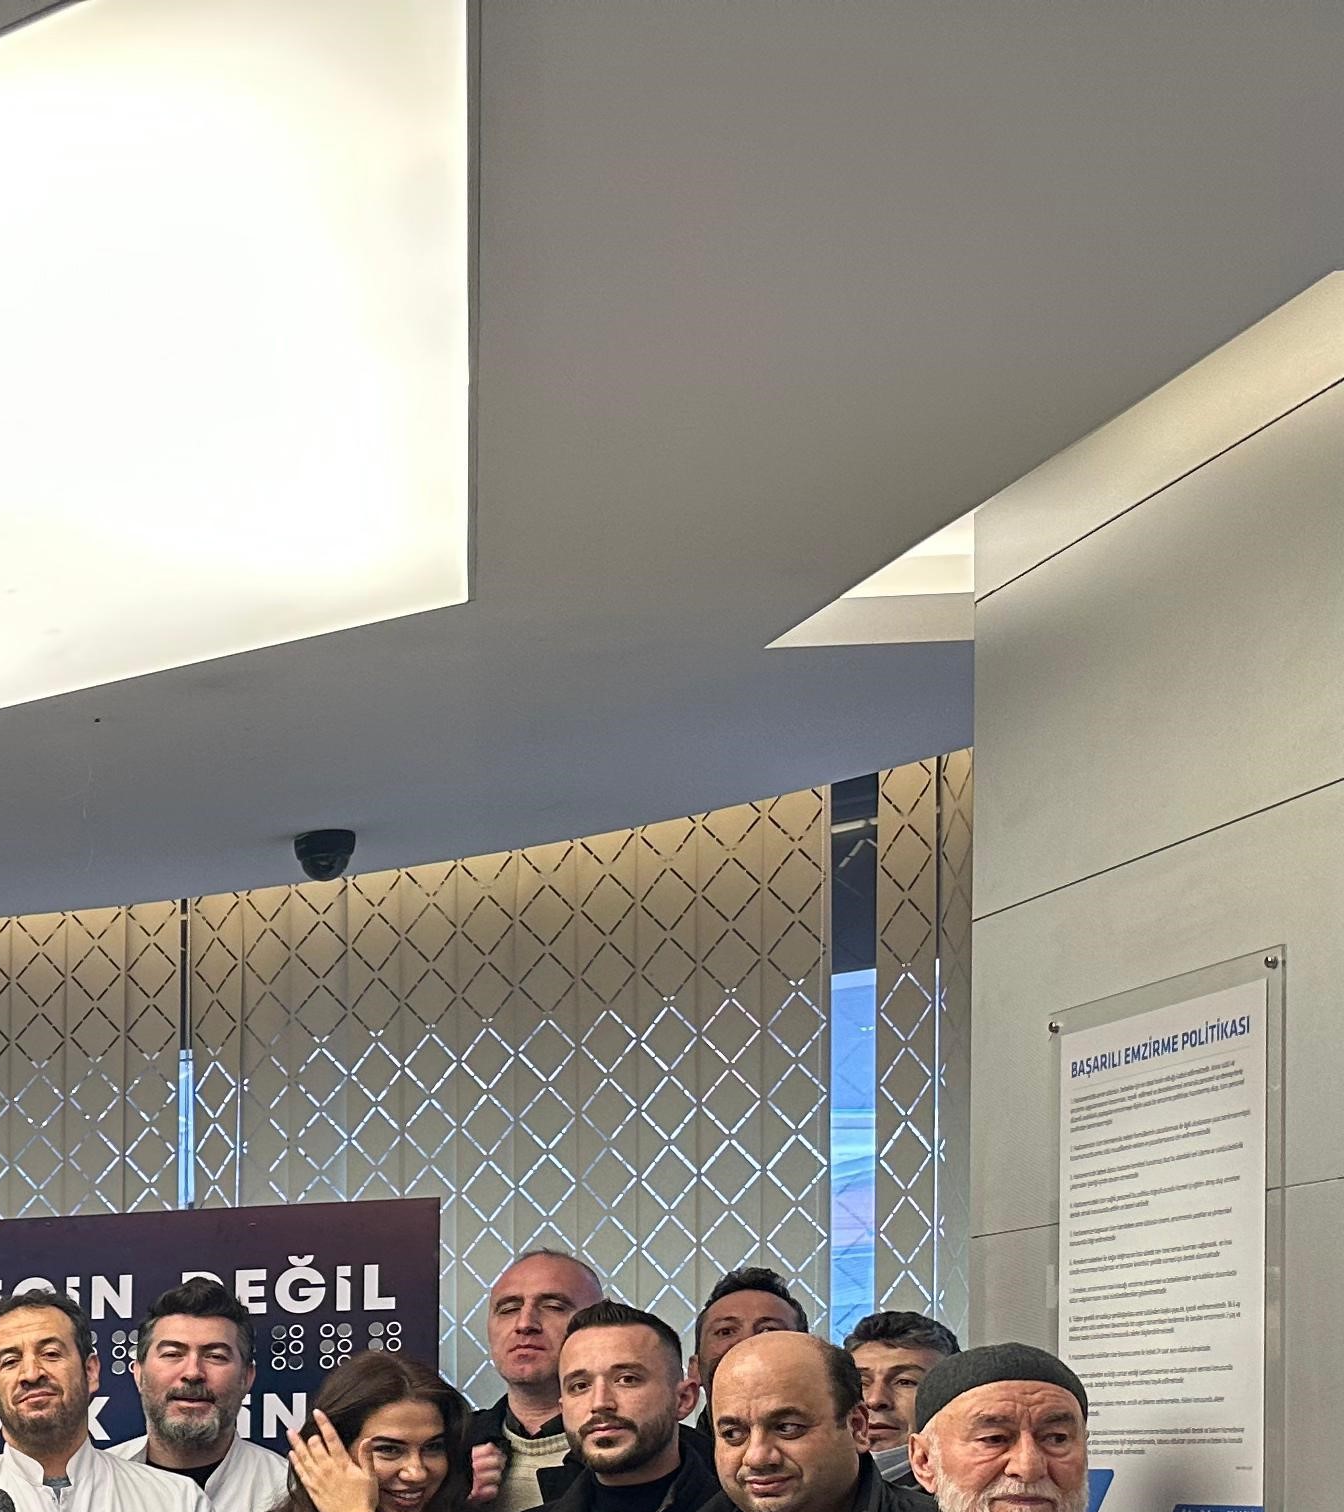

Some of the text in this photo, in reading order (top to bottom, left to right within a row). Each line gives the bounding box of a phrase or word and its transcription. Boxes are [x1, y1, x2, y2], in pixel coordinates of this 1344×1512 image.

[1071, 1015, 1250, 1078] BAŞARILI EMZİRME POLİTİKASI
